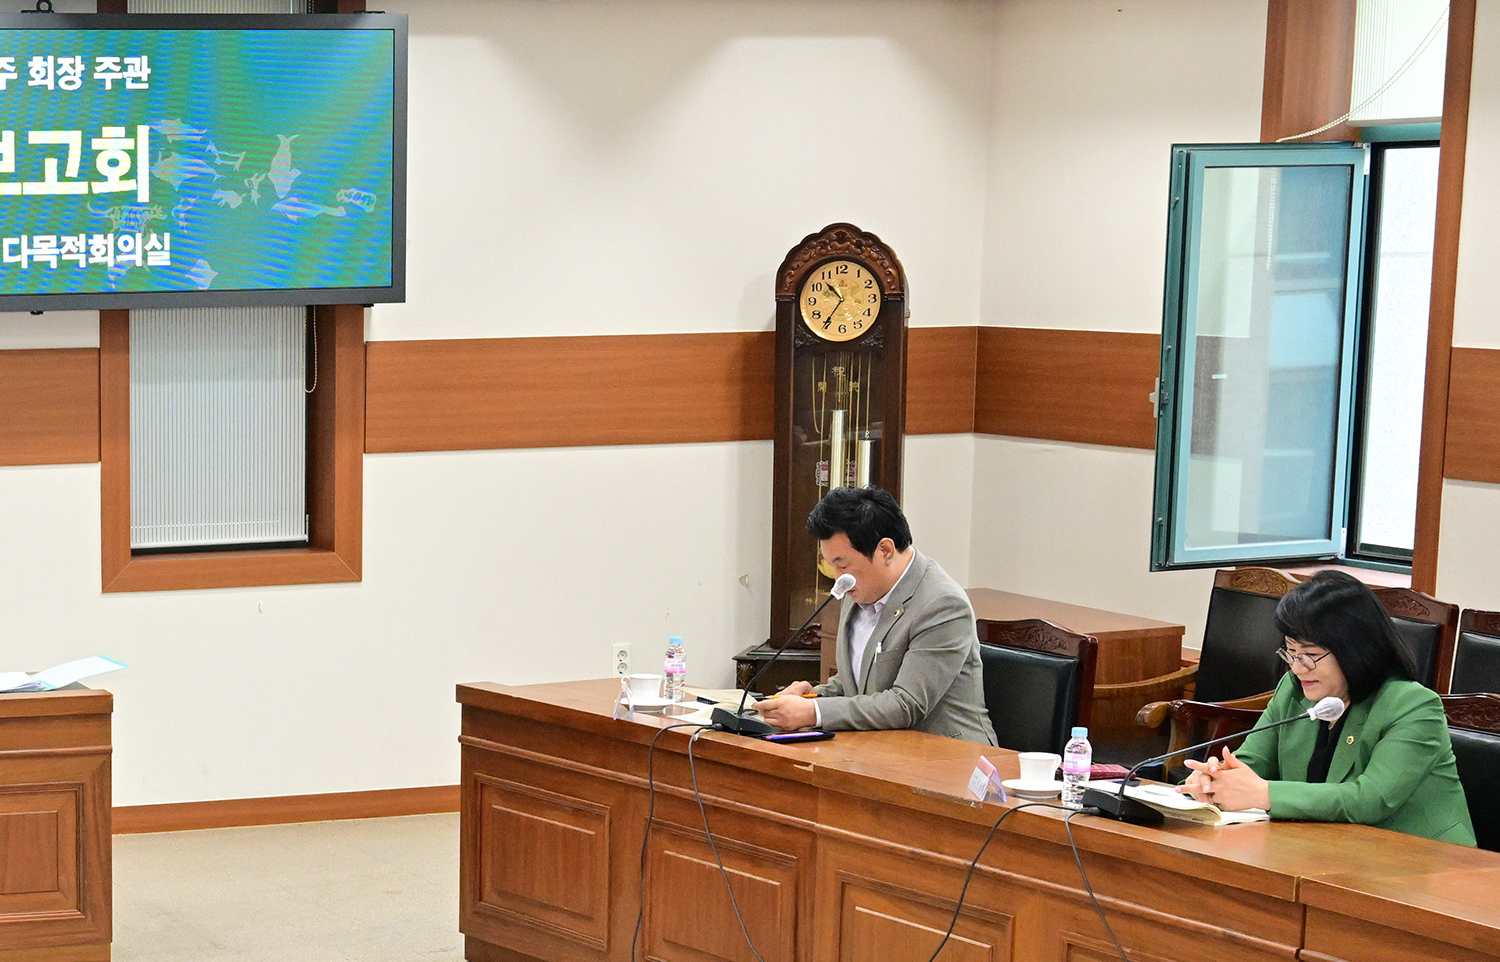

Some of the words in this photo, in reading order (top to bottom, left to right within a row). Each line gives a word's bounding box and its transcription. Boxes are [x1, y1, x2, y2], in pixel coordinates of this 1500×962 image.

[27, 55, 85, 91] 회장
[93, 55, 152, 90] 주관
[2, 232, 171, 269] 다목적회의실
[835, 264, 848, 275] 12
[821, 270, 832, 280] 11
[811, 282, 822, 292] 10
[864, 280, 873, 289] 2
[808, 297, 817, 306] 9
[868, 294, 877, 303] 3
[811, 310, 821, 319] 8
[863, 308, 871, 317] 4
[838, 324, 847, 334] 6
[853, 319, 863, 329] 5
